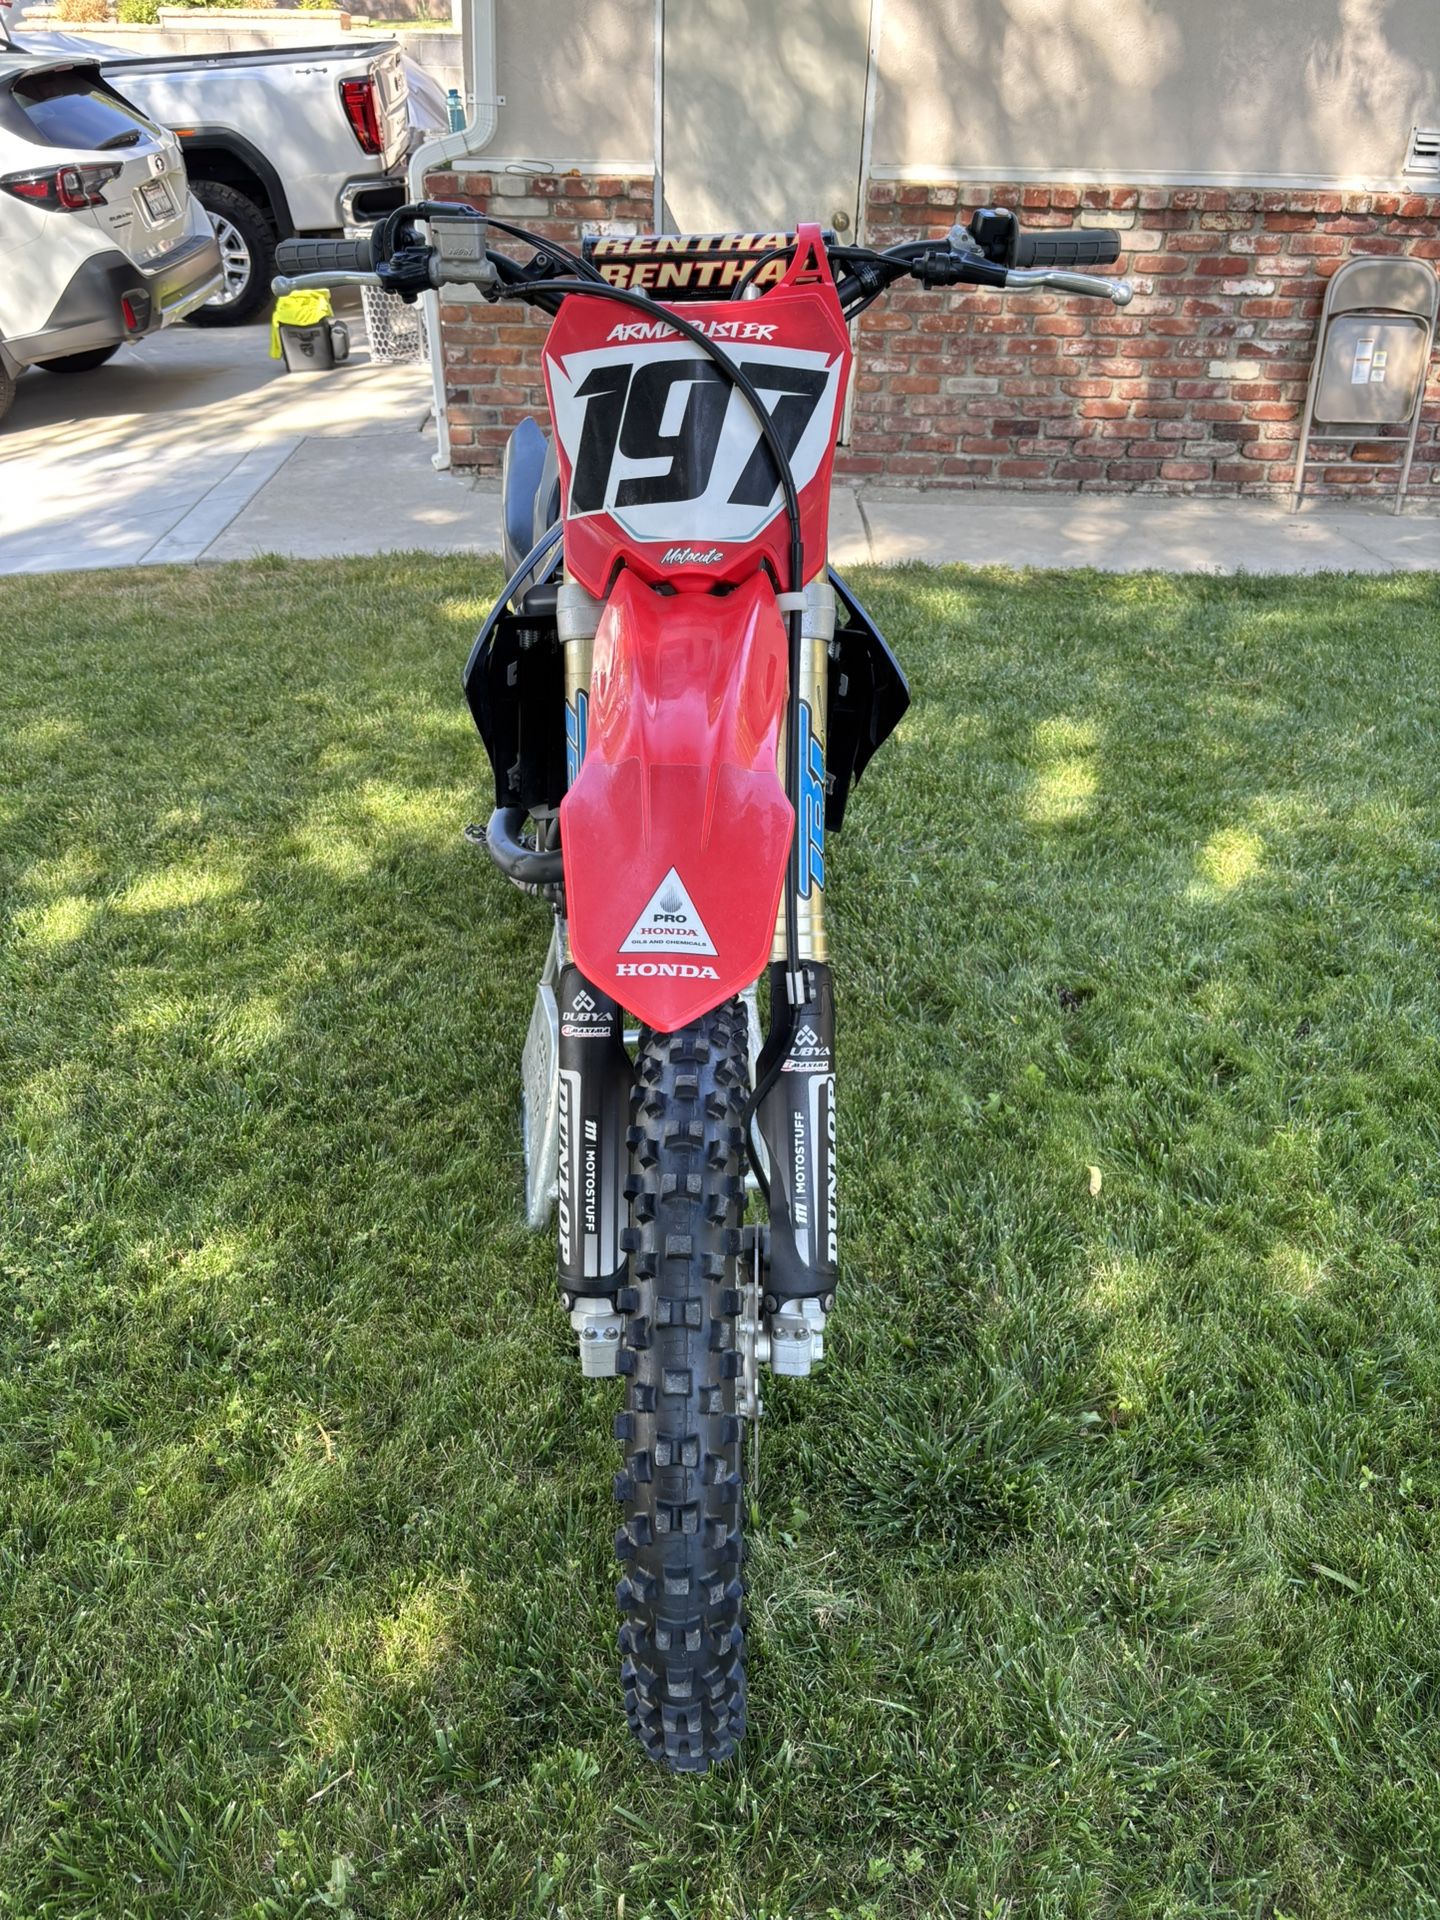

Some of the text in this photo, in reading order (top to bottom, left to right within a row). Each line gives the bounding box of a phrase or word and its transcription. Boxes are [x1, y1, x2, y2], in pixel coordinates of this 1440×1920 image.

[593, 233, 799, 255] RENTHA
[572, 359, 829, 514] 197
[653, 914, 687, 923] PRO
[640, 927, 699, 936] HONDA
[665, 939, 707, 947] CHEMICALS
[616, 963, 721, 980] HONDA
[562, 1012, 614, 1022] DUBYA
[789, 1046, 831, 1057] UBYA
[794, 1111, 806, 1193] MOTOSTUFF
[558, 1073, 571, 1266] DUNLOP
[827, 1078, 838, 1266] DUNLOP
[585, 1151, 596, 1232] MOTOSTUFF
